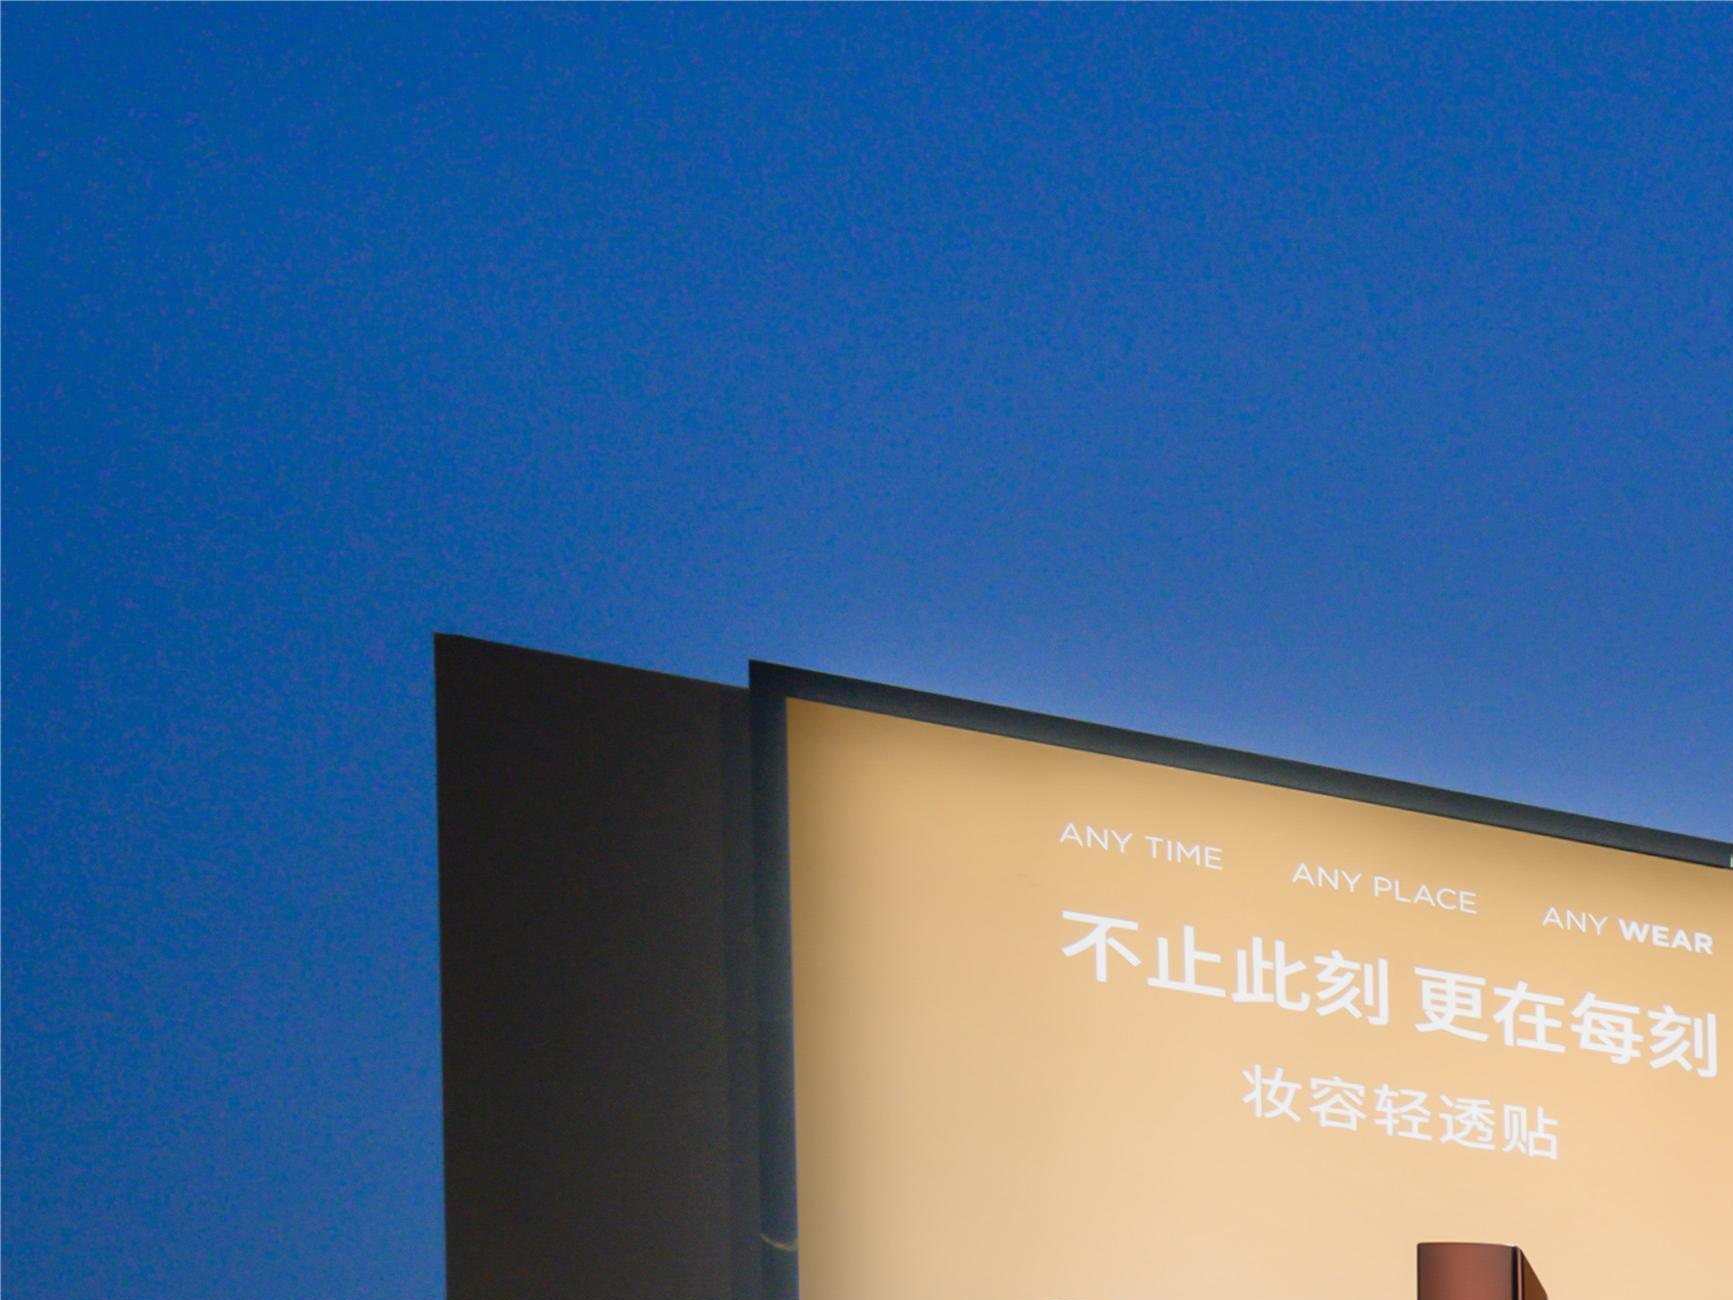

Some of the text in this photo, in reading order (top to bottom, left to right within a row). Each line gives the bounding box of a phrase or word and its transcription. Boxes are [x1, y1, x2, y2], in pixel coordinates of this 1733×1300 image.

[1060, 822, 1223, 870] ANY TIME
[1292, 863, 1478, 914] ANY PLACE
[1542, 907, 1714, 955] ANY WEAR
[1061, 909, 1719, 1079] 不止此刻 更在每刻
[1242, 1064, 1559, 1160] 妆容轻透贴
